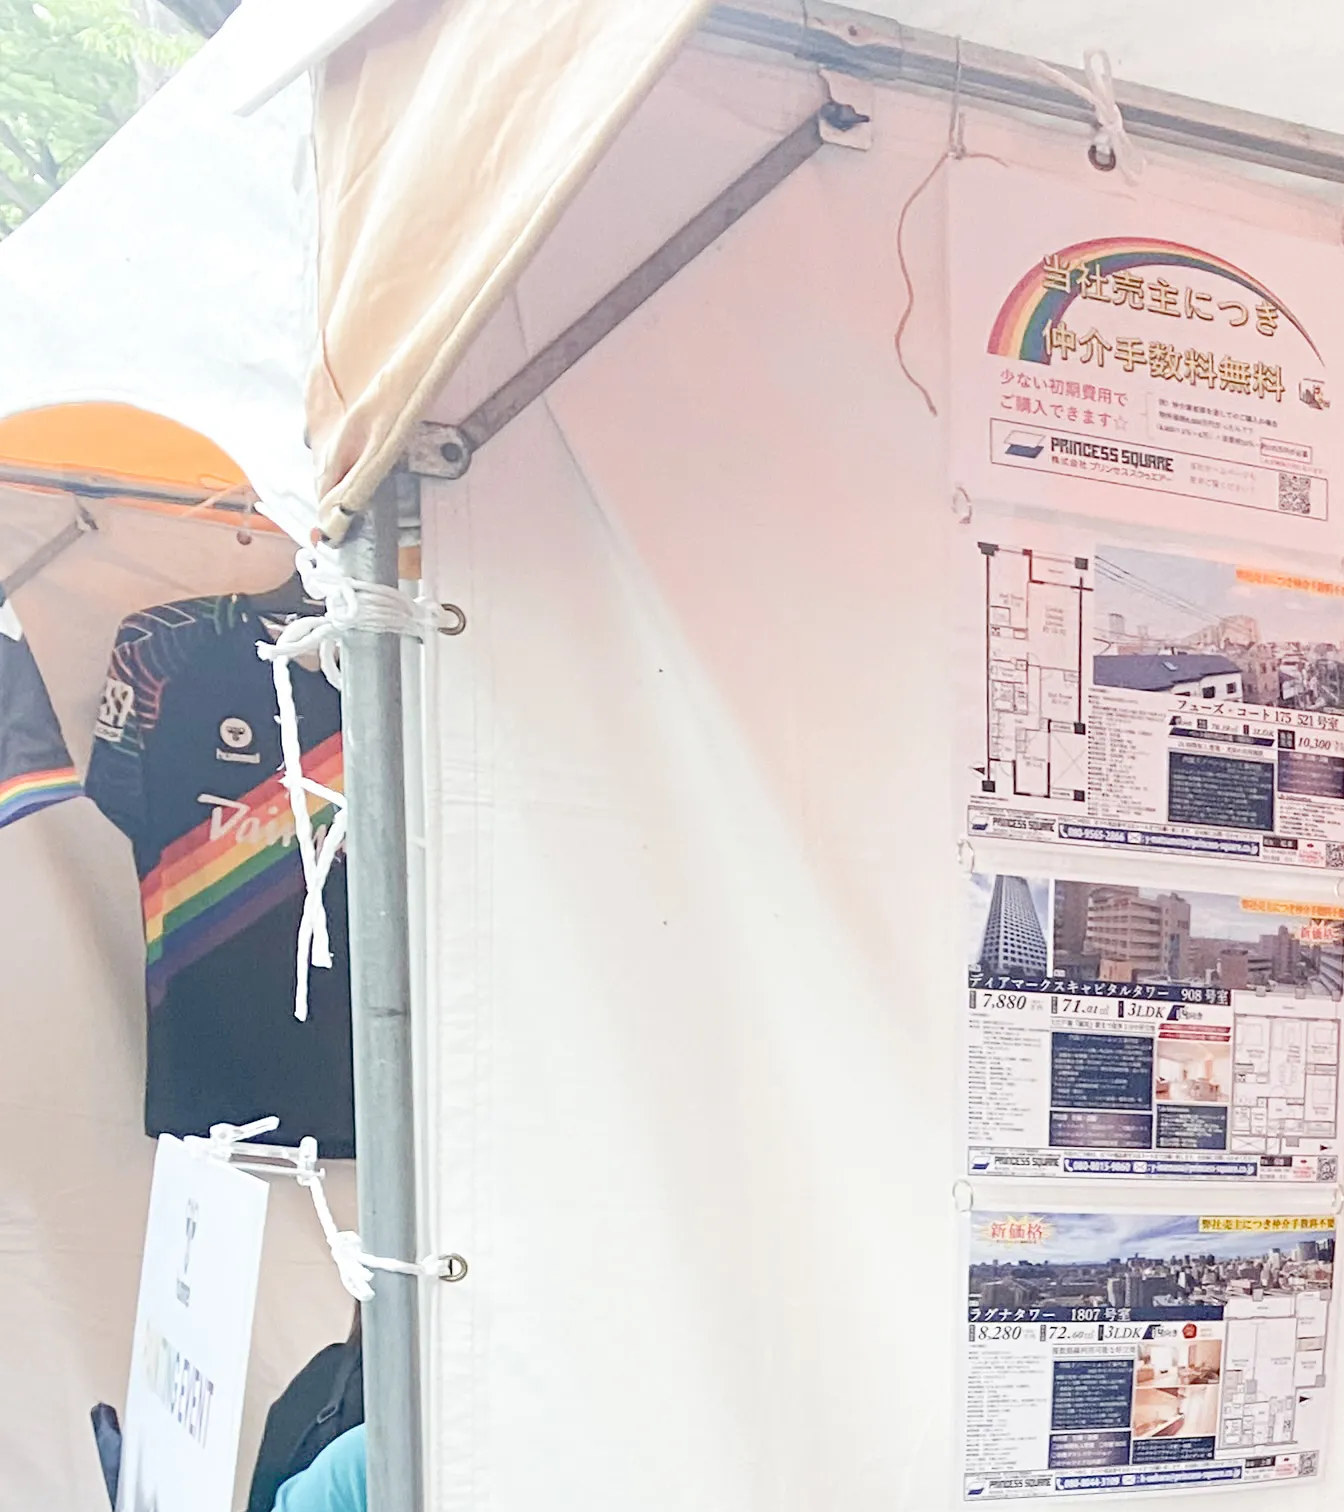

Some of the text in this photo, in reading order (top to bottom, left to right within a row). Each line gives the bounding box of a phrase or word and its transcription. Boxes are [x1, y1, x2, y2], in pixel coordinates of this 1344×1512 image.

[1043, 254, 1280, 337] 当社売主につき
[1042, 318, 1286, 402] 仲介手数料無料
[1000, 368, 1128, 407] 少ない初期費用で
[1051, 437, 1174, 473] PRINCESS SQUARE
[969, 976, 1169, 999] ディアマークスキャピタルタワー
[983, 993, 1026, 1011] 7,880
[1128, 1003, 1165, 1019] 3LDK
[990, 1222, 1043, 1240] 新価格
[969, 1308, 1131, 1322] ラグナタワー 1807号室
[978, 1325, 1021, 1341] 8,280
[1105, 1325, 1142, 1339] 3LDK
